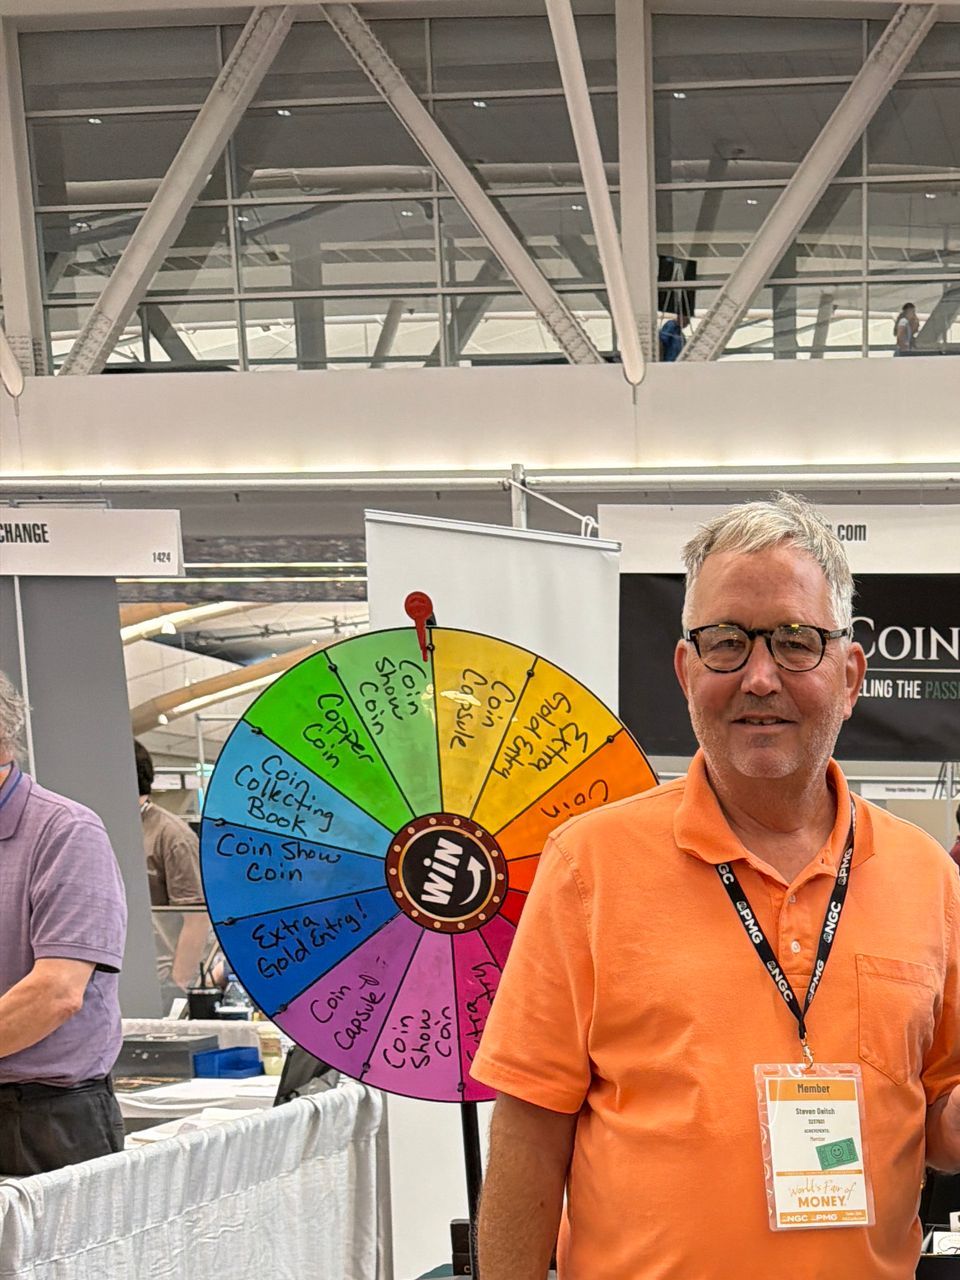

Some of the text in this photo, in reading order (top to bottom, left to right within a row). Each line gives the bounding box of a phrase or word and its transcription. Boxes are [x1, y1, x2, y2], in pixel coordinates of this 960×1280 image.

[834, 524, 867, 541] com
[152, 552, 171, 563] 1424
[375, 656, 403, 720] Show
[399, 660, 427, 715] Coin
[481, 680, 516, 728] Coin
[858, 680, 893, 698] LING
[896, 680, 921, 699] THE
[360, 681, 385, 735] Coin
[524, 692, 572, 740] Gold
[303, 723, 340, 768] Coin
[528, 722, 588, 772] Extra
[261, 754, 310, 794] Coin
[235, 764, 335, 833] Collecting
[247, 796, 308, 837] Book
[216, 833, 342, 864] Coin Show
[840, 848, 854, 881] PMG
[717, 863, 734, 885] GC
[252, 914, 320, 950] Extra
[739, 906, 764, 945] PMG
[828, 901, 842, 935] NGC
[257, 938, 312, 978] Gold
[810, 959, 825, 996] PMG
[310, 985, 351, 1024] Coin
[771, 968, 794, 1002] NGC
[383, 1015, 415, 1069] Coin
[410, 1009, 431, 1069] Show
[434, 1006, 453, 1057] Coin
[797, 1083, 830, 1094] Member
